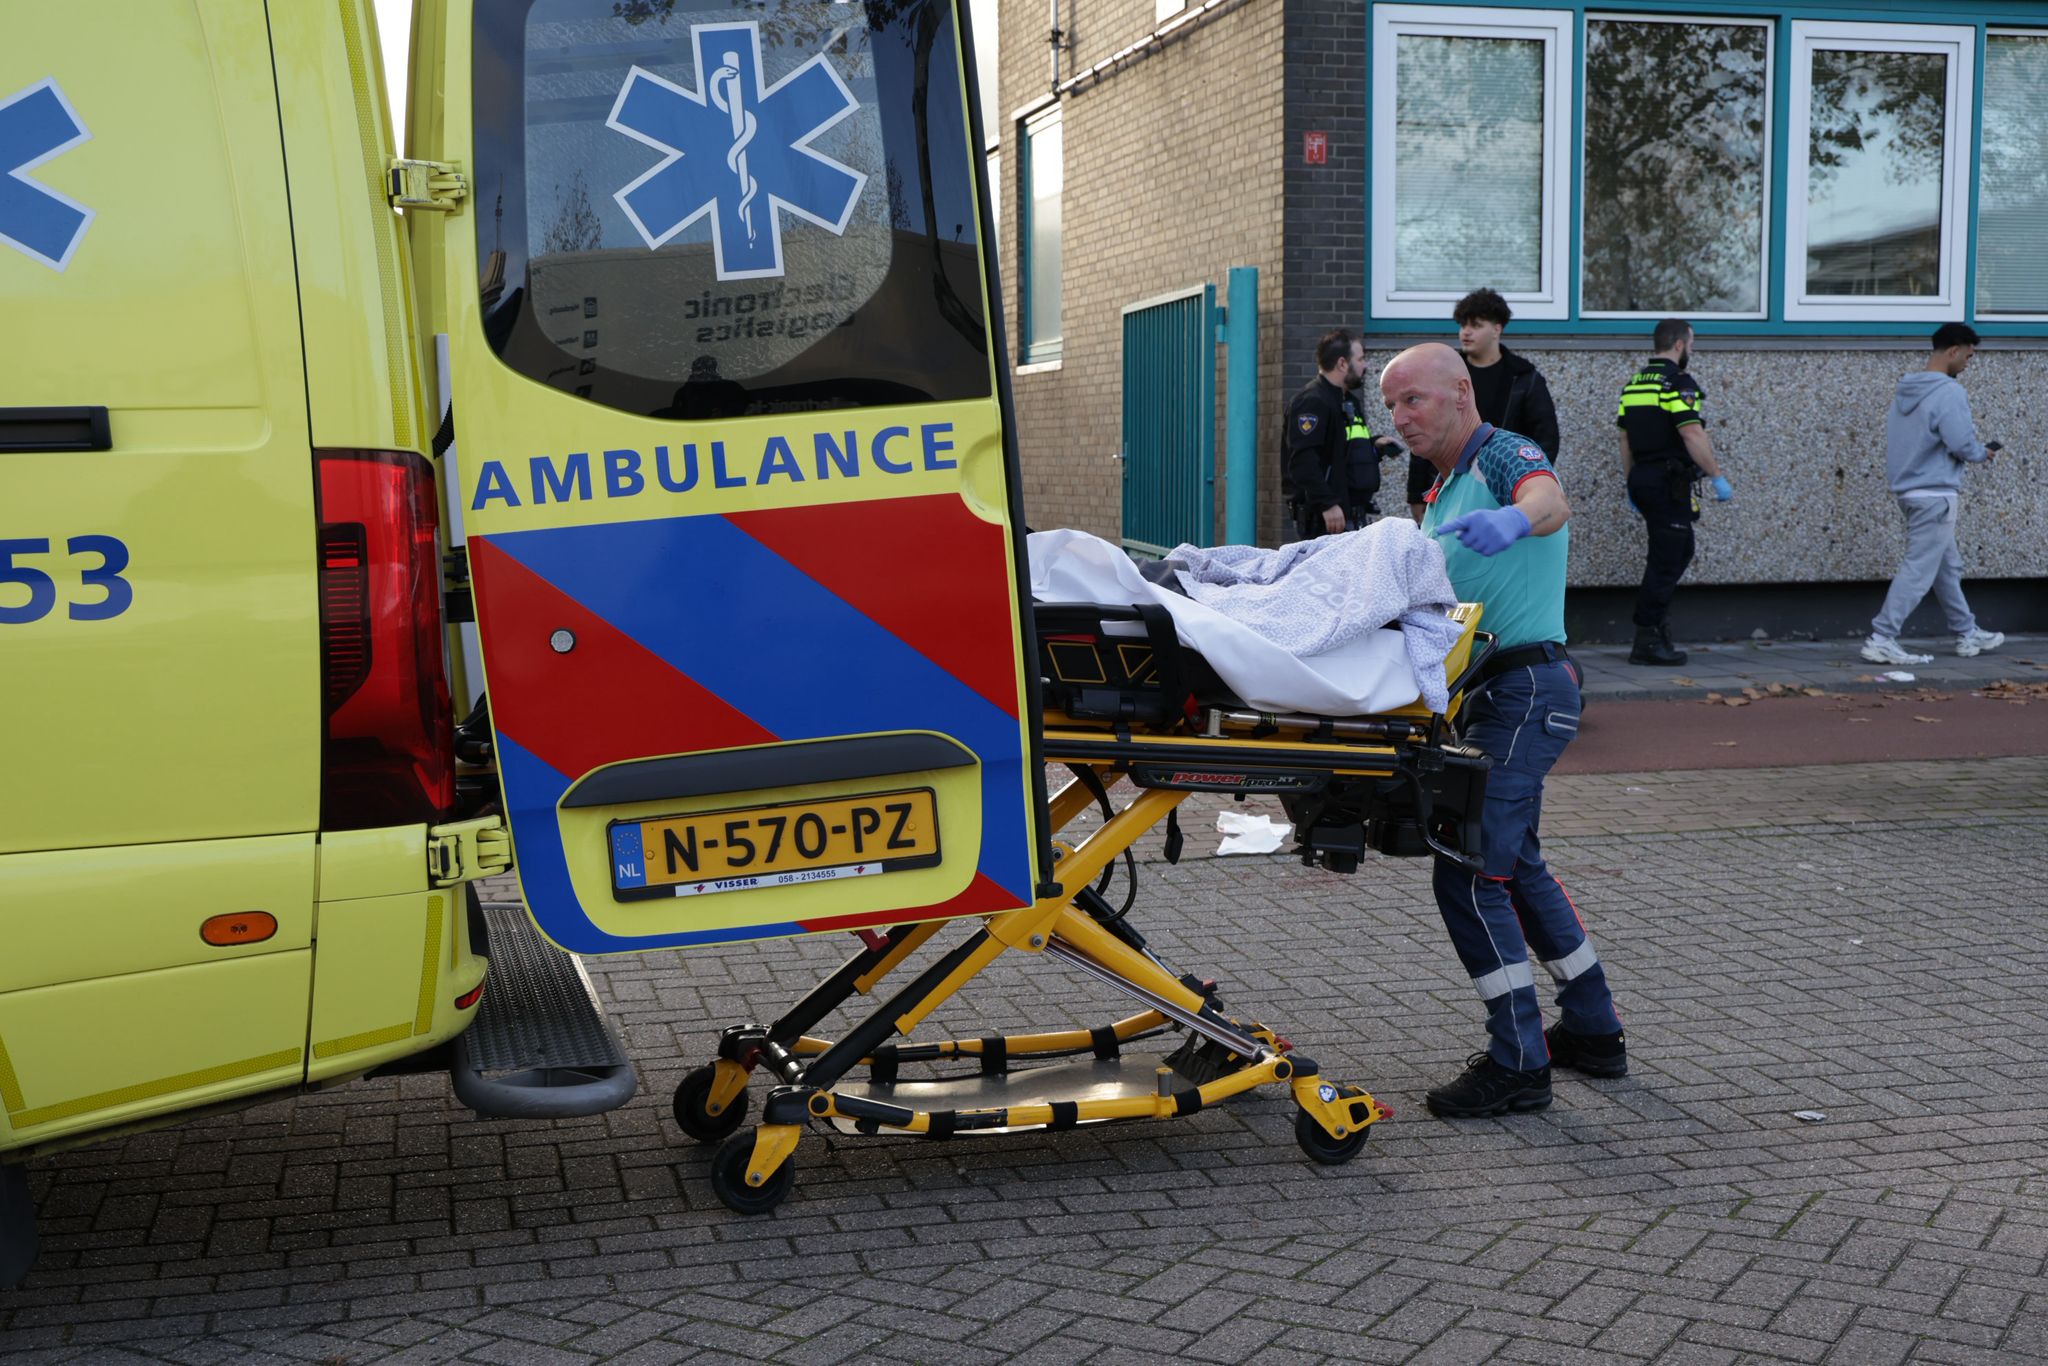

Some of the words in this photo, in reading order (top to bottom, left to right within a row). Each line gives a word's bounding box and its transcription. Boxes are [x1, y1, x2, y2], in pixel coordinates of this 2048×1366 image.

[471, 422, 957, 511] AMBULANCE
[0, 534, 133, 624] 53
[618, 862, 642, 879] NL
[663, 802, 916, 875] N-570-PZ
[715, 878, 758, 890] VISSER
[778, 874, 794, 884] 058
[801, 869, 837, 881] 2134555
